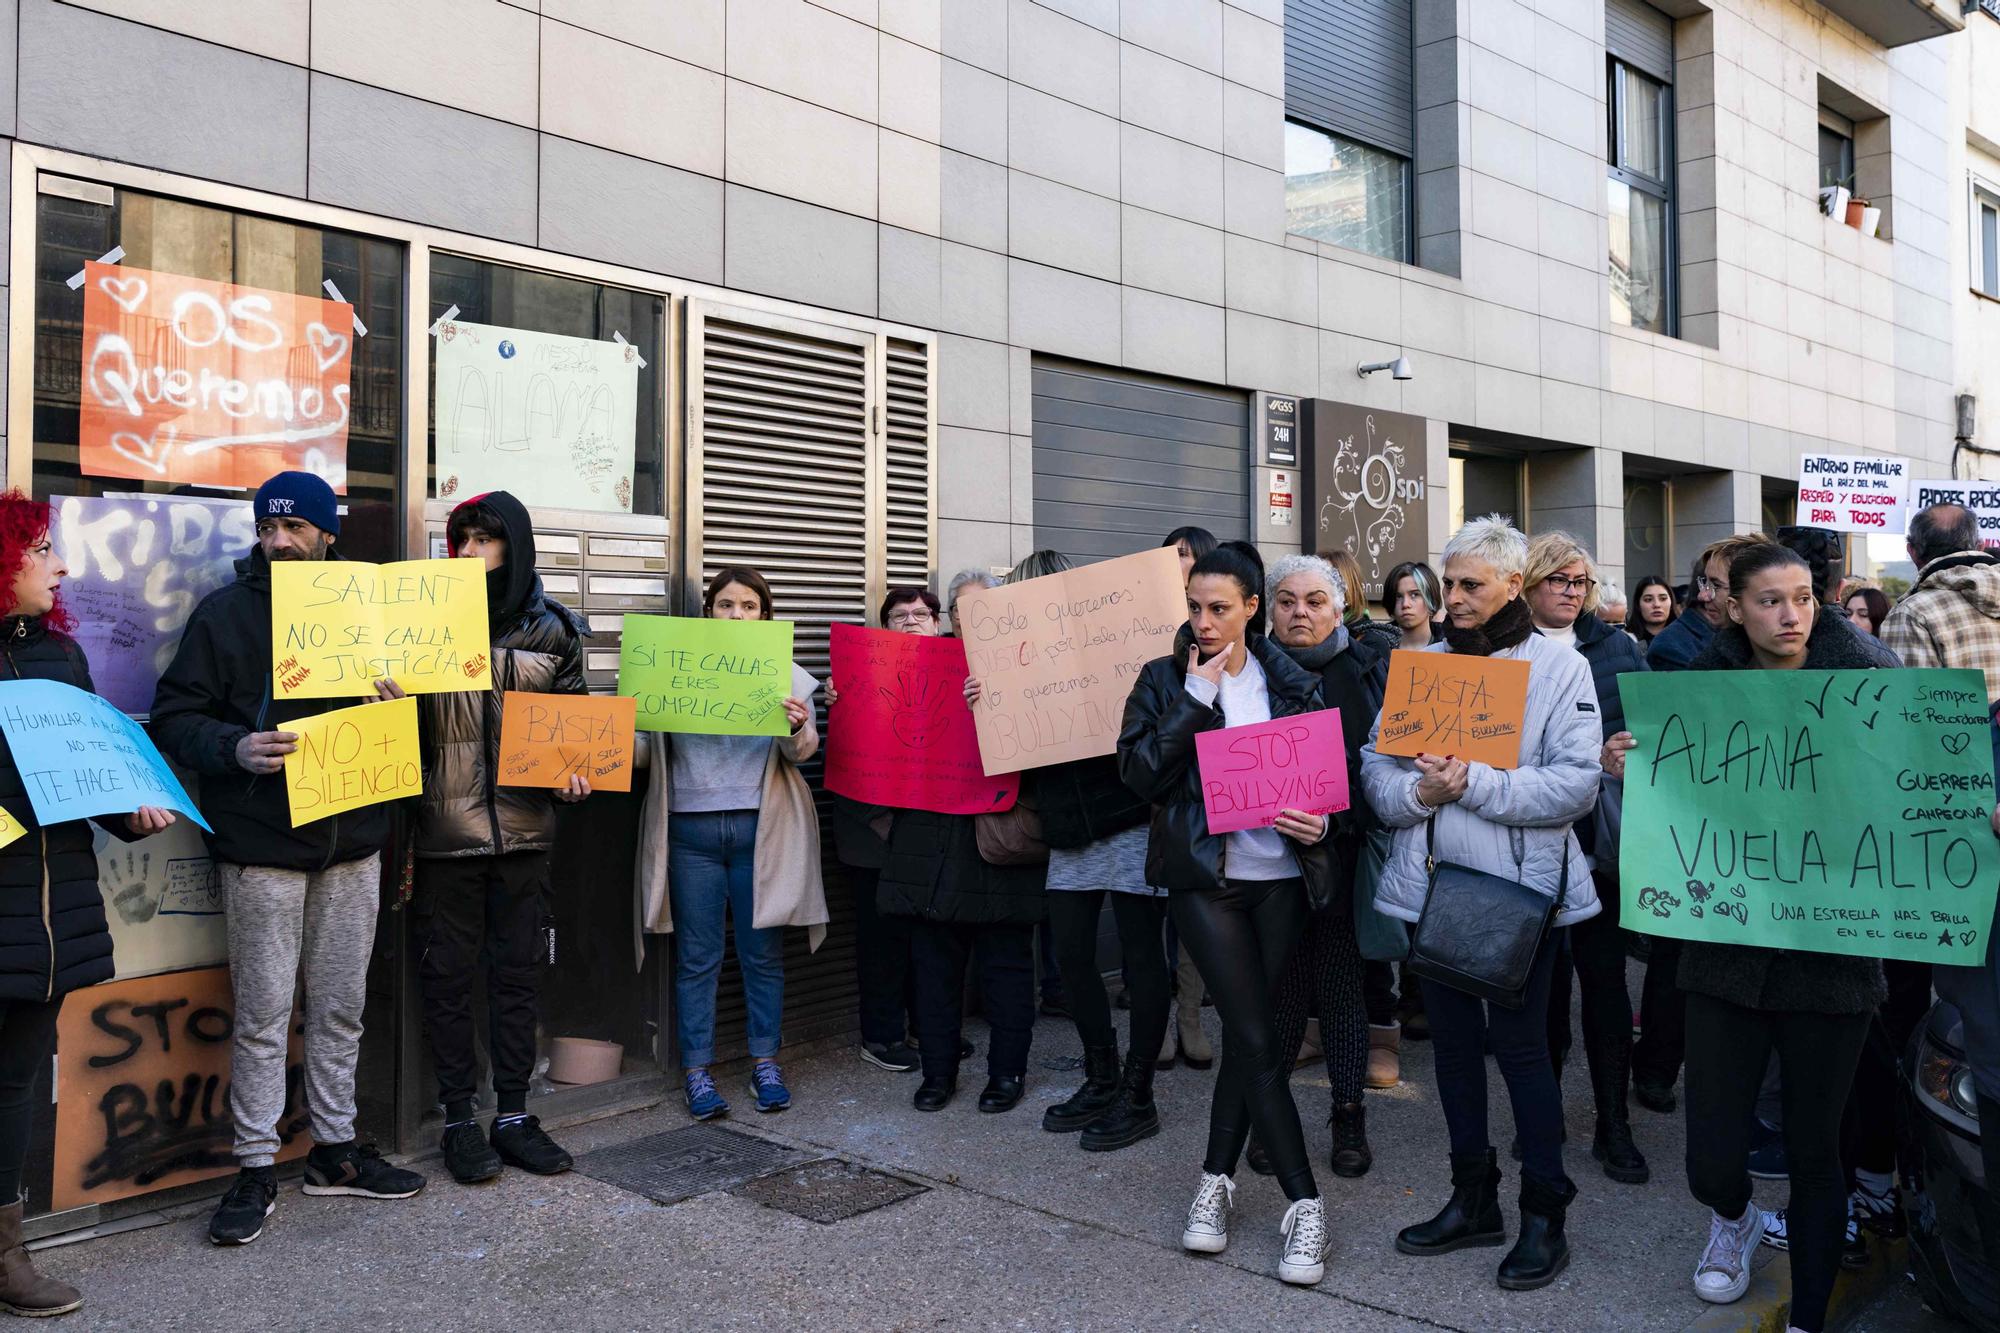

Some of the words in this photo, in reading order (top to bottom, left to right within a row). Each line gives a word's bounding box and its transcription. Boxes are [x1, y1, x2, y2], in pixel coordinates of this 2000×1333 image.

[172, 292, 283, 352] OS
[89, 333, 350, 424] Queremos
[1278, 400, 1294, 413] GSS
[1274, 426, 1290, 442] 24H
[1804, 458, 1848, 474] ENTORNO
[1854, 459, 1902, 476] FAMILIAR
[1800, 488, 1834, 503] RESPETO
[1839, 493, 1848, 504] Y
[1822, 477, 1833, 488] LA
[1858, 479, 1868, 488] DEL
[1872, 480, 1888, 488] MAL
[268, 499, 294, 514] NY
[1918, 488, 1964, 509] PADRES
[1969, 487, 2000, 508] RACIS
[1811, 509, 1836, 523] PARA
[1848, 510, 1886, 527] TODOS
[1044, 588, 1134, 634] queremos
[286, 622, 327, 650] NO
[338, 626, 370, 647] SE
[384, 626, 454, 646] CALLA
[1044, 636, 1076, 666] por
[1122, 628, 1132, 646] y
[1133, 617, 1177, 636] Alana
[275, 655, 299, 679] IVAN
[462, 653, 486, 677] LEILA
[664, 650, 694, 673] TE
[700, 653, 778, 676] CALLAS
[281, 665, 312, 694] ALANA
[672, 676, 720, 690] ERES
[977, 680, 1002, 714] No
[1023, 671, 1100, 710] queremos
[1114, 654, 1144, 679] má
[1406, 666, 1494, 710] BASTA
[632, 691, 750, 723] COMPLICE
[1913, 686, 1979, 708] Siempre
[4, 704, 84, 734] HUMILLAR
[521, 704, 622, 744] BASTA
[1426, 708, 1470, 748] YA
[1899, 706, 1922, 723] te
[1384, 720, 1424, 739] BULLYING
[1471, 722, 1516, 738] BULLYING
[67, 740, 85, 753] NO
[88, 740, 107, 753] TE
[302, 721, 362, 776] NO
[1224, 726, 1311, 773] STOP
[1650, 714, 1823, 794] ALANA
[554, 747, 597, 780] YA
[26, 770, 72, 806] TE
[75, 765, 124, 795] HACE
[294, 761, 419, 810] SILENCIO
[1204, 769, 1335, 816] BULLYING
[1896, 769, 1992, 793] GUERRERA
[1902, 808, 1988, 822] CAMPEONA
[1669, 818, 1828, 884] VUELA
[1850, 824, 1978, 890] ALTO
[1772, 902, 1806, 920] UNA
[1814, 905, 1880, 920] ESTRELLA
[1837, 928, 1858, 938] EN
[1866, 930, 1885, 938] EL
[88, 998, 234, 1068] STO
